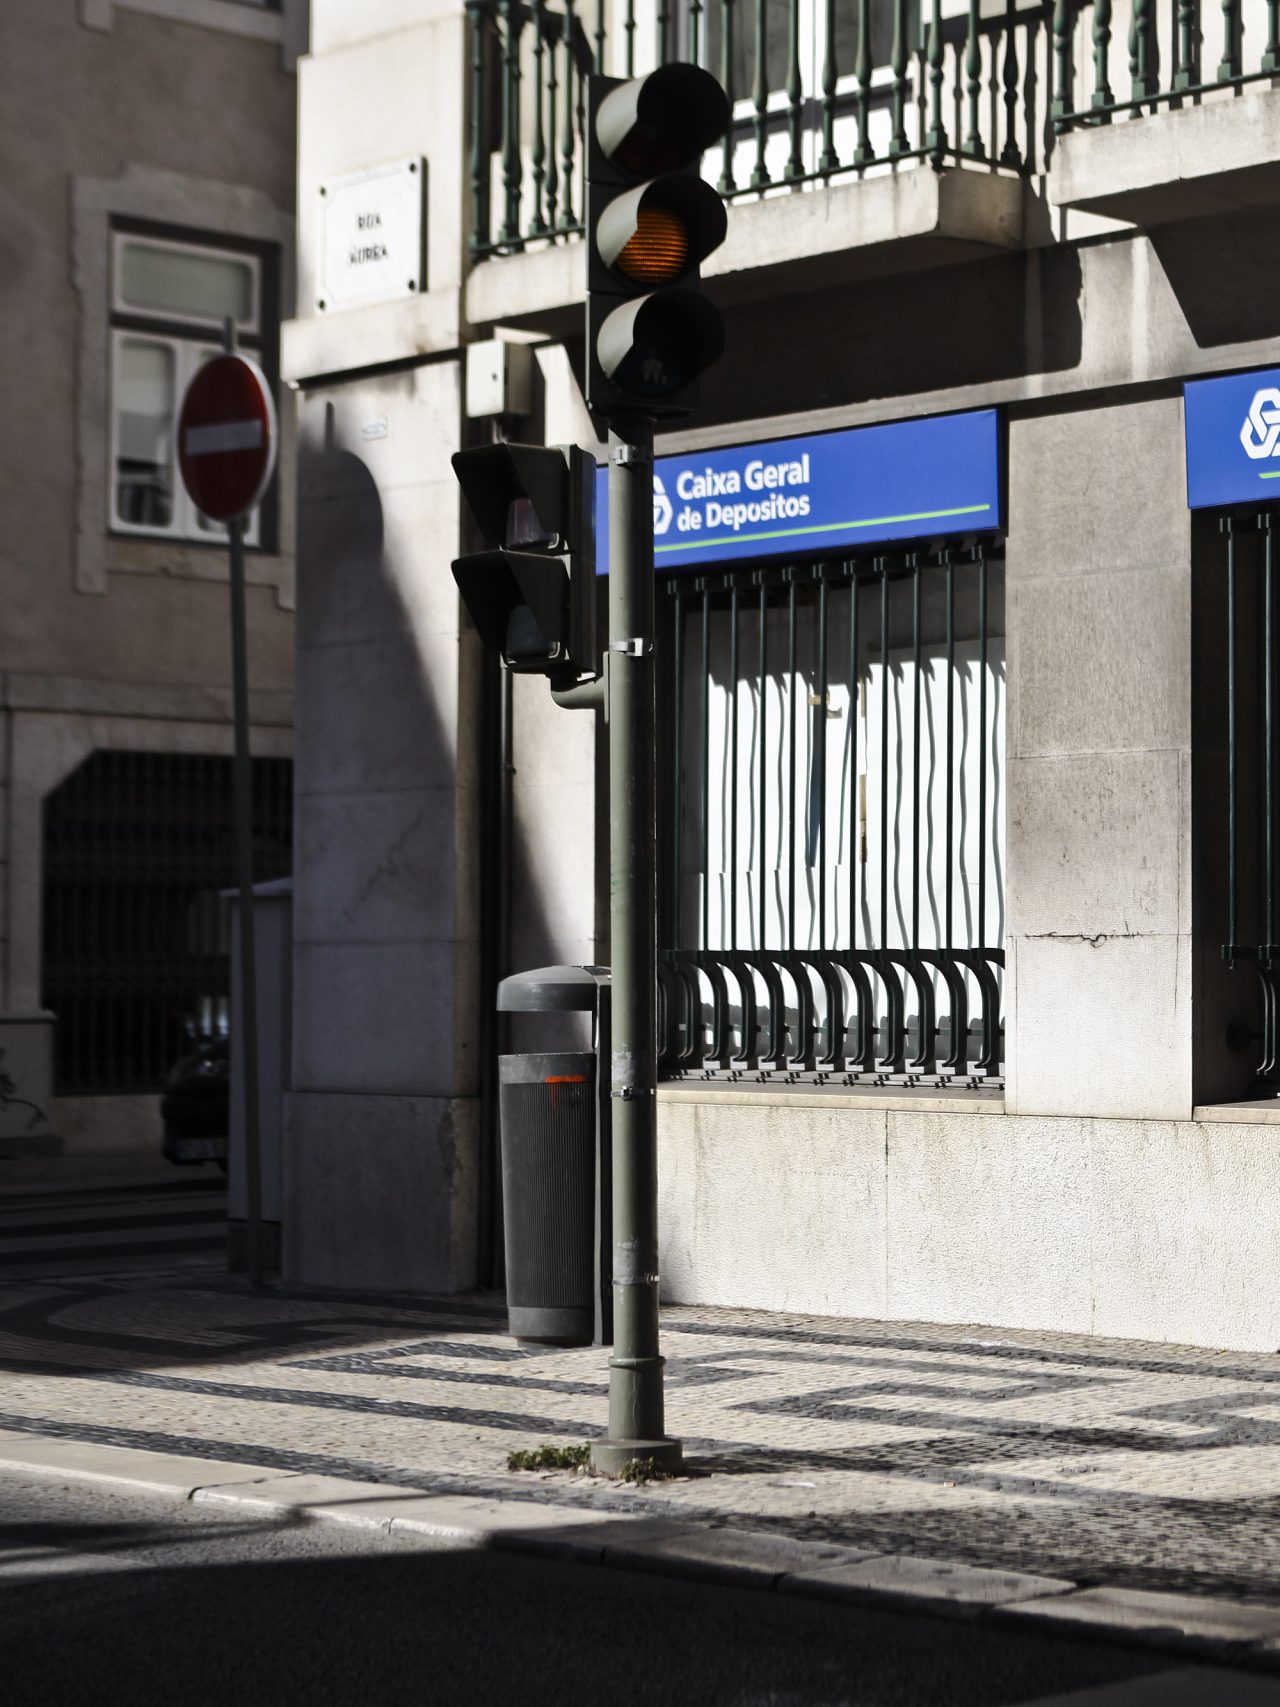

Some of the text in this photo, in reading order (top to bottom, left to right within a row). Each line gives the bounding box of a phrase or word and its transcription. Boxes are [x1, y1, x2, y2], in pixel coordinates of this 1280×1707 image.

[676, 453, 810, 501] Caixa Geral
[677, 505, 703, 532] de
